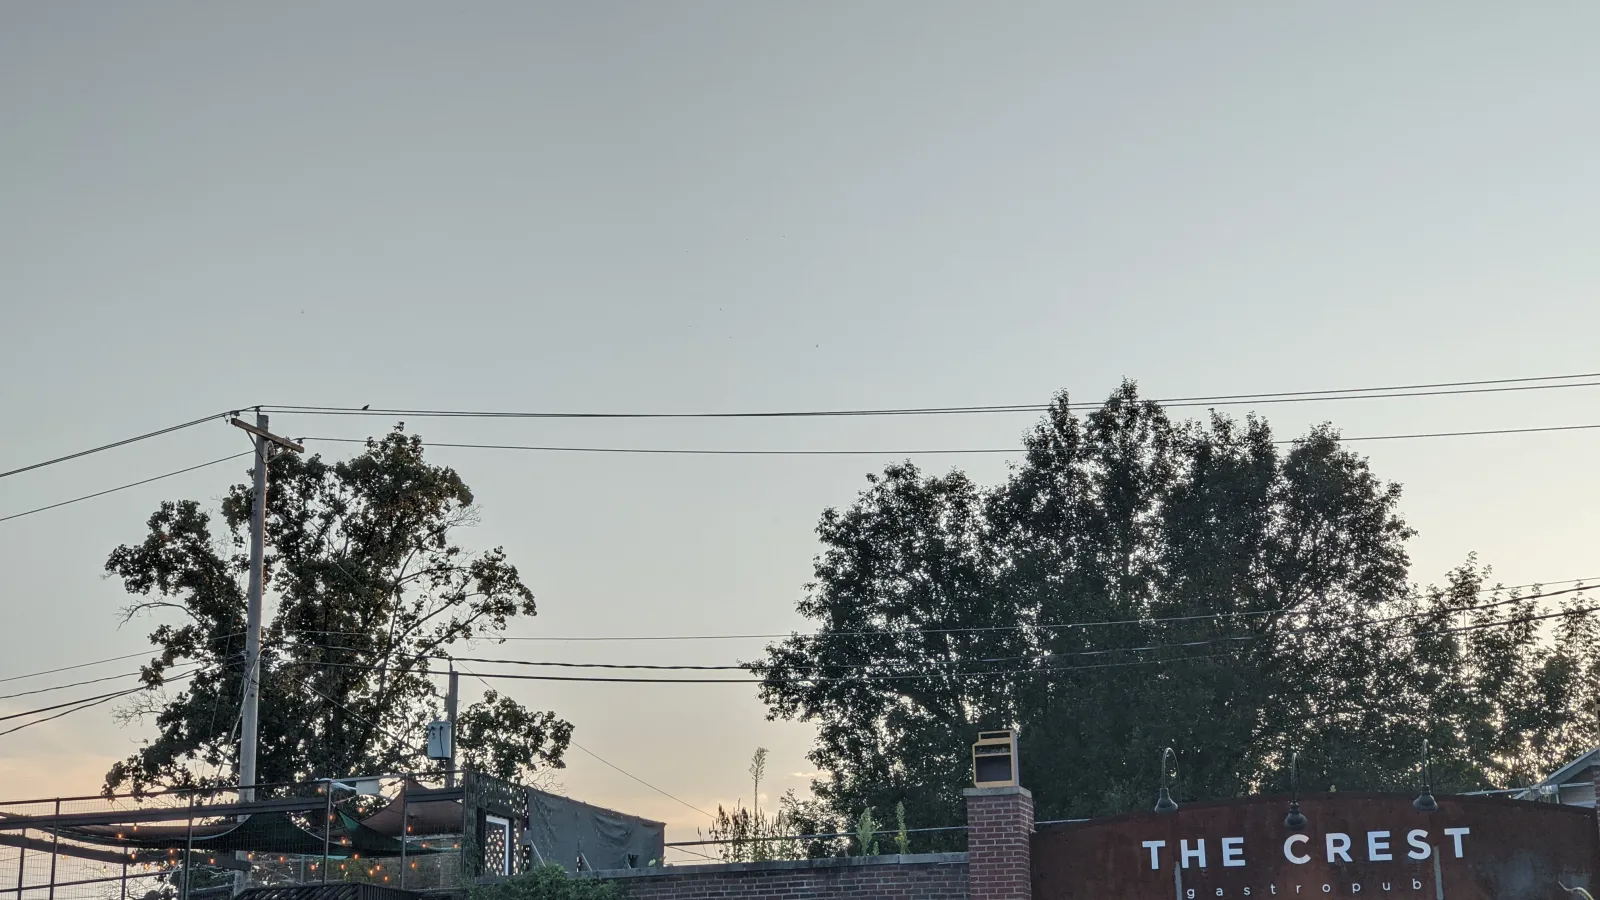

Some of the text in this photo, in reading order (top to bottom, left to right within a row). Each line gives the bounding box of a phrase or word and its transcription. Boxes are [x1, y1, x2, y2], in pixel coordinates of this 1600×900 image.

[1142, 827, 1470, 870] THE CREST
[1186, 878, 1422, 899] gastropub
